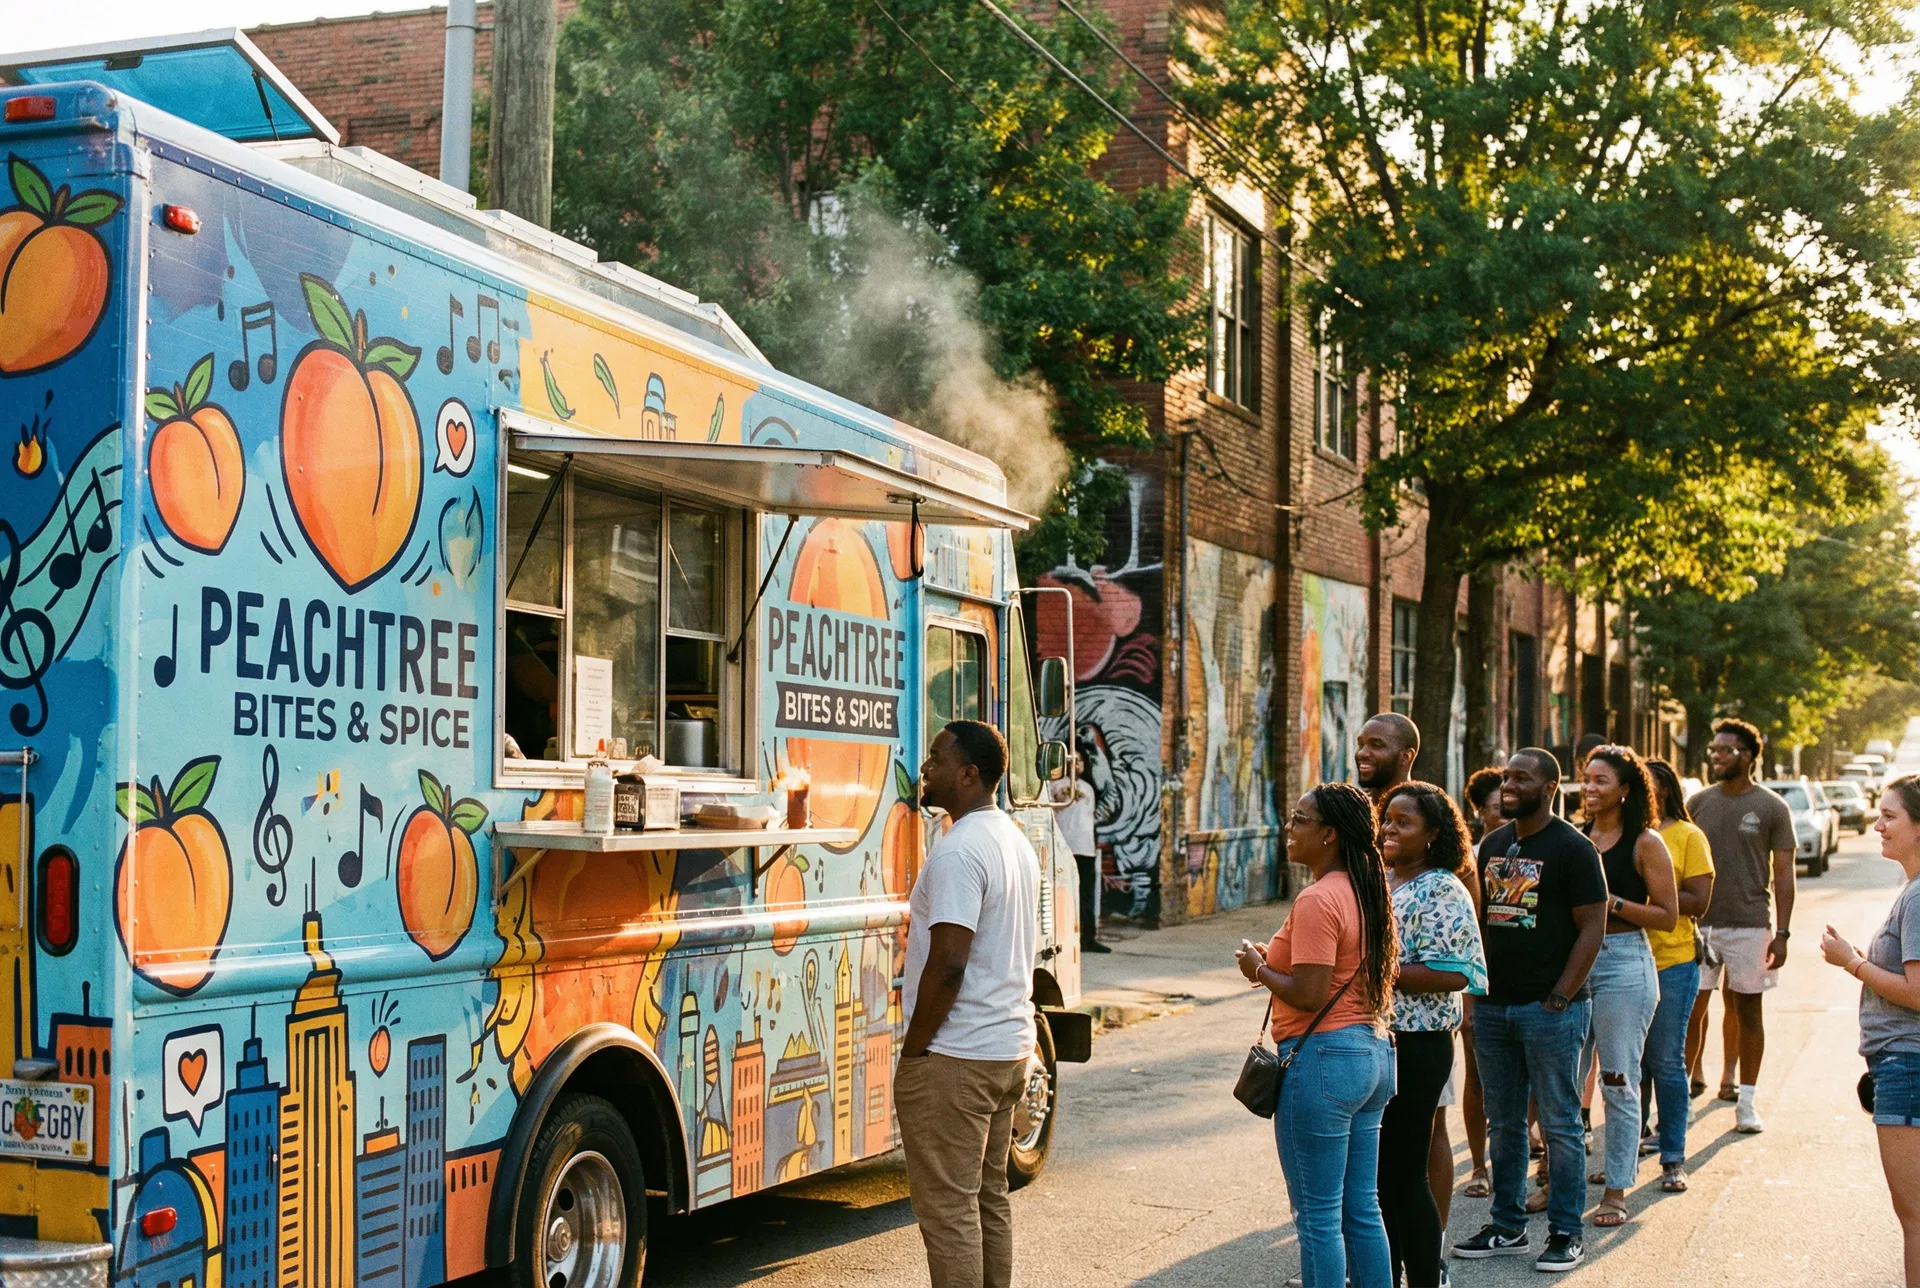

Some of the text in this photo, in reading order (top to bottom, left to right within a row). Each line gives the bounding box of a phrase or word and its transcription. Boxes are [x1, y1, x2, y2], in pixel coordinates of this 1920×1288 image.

[200, 586, 479, 700] PEACHTREE
[768, 607, 906, 691] PEACHTREE
[233, 691, 470, 749] BITES & SPICE
[785, 690, 892, 730] BITES & SPICE
